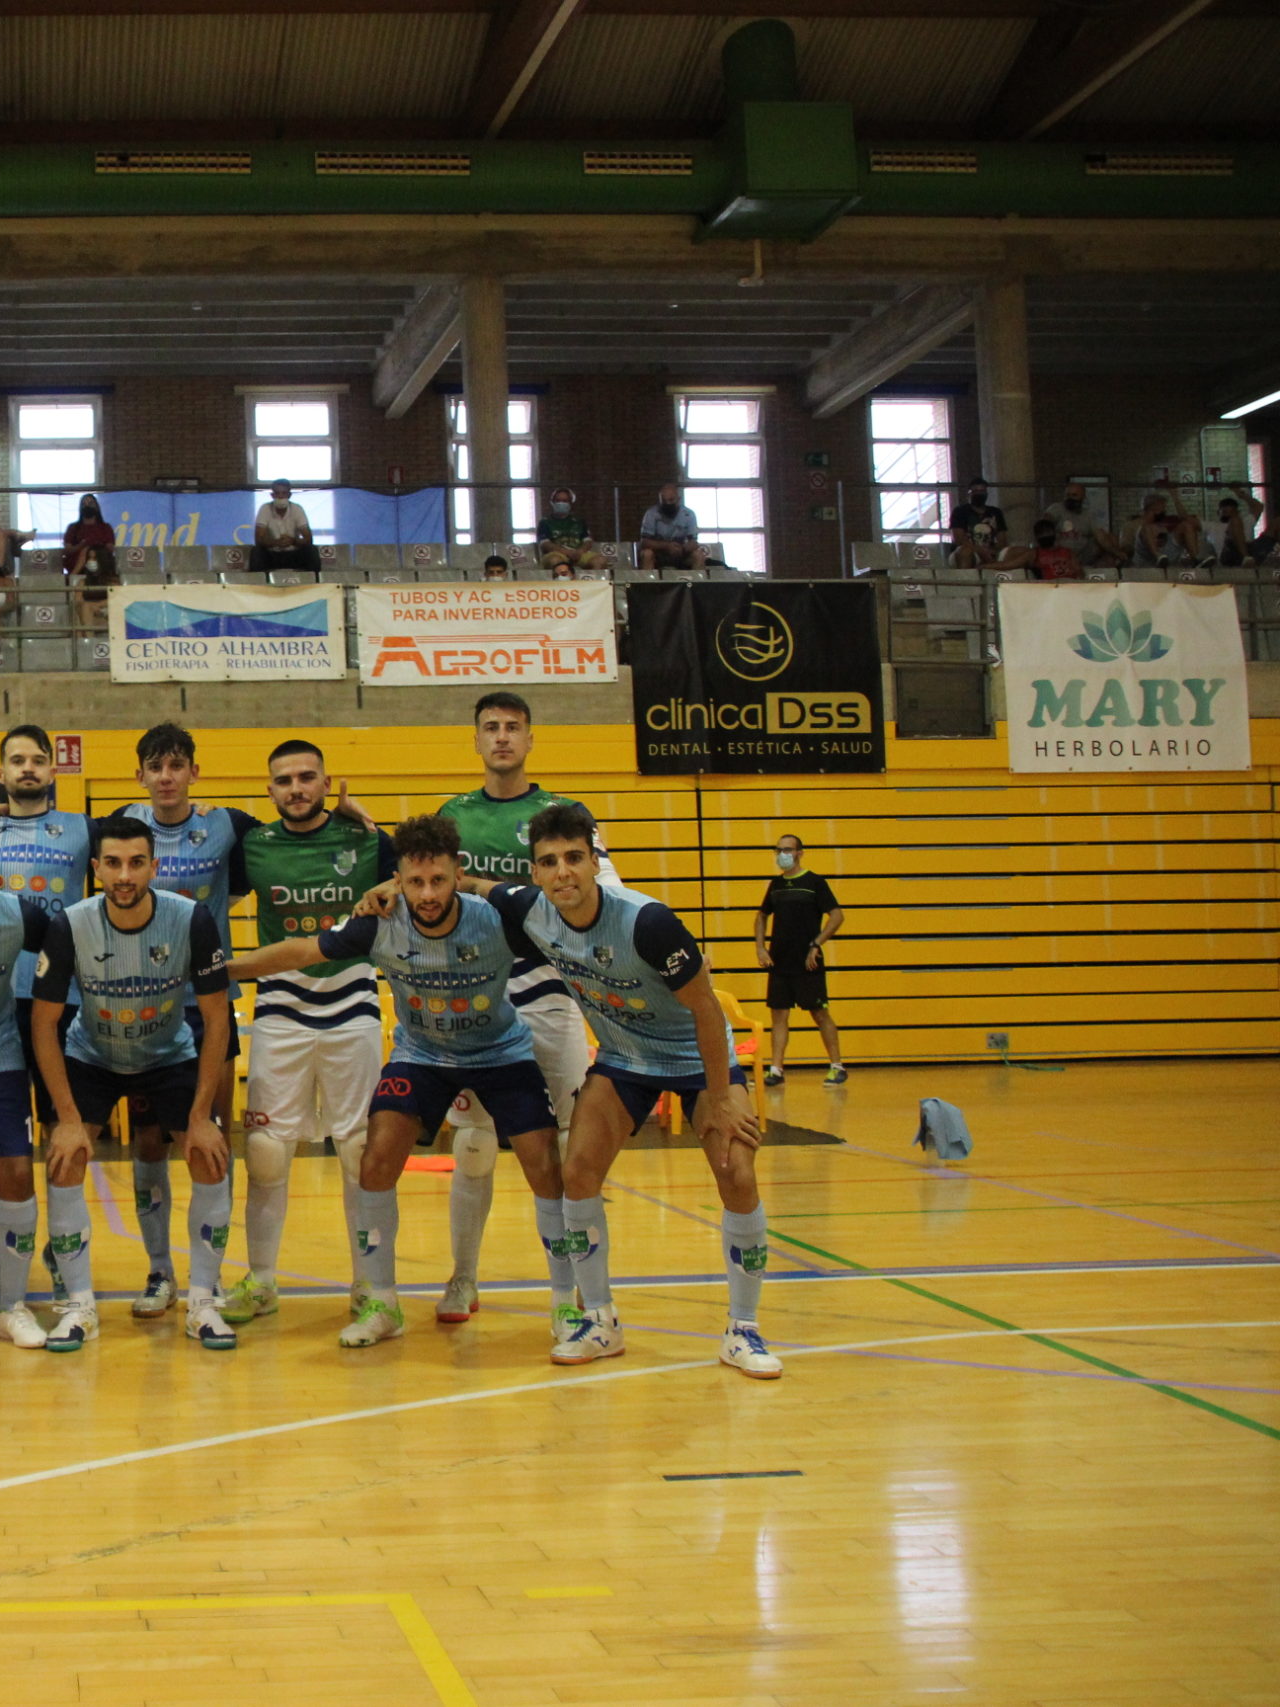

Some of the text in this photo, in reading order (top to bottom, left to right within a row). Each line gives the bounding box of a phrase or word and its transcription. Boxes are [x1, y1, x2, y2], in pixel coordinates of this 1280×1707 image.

[114, 511, 201, 552] imd
[390, 591, 448, 605] TUBOS
[452, 591, 463, 603] Y
[393, 606, 577, 621] PARA INVERNADEROS
[126, 640, 328, 659] CENTRO ALHAMBRA
[371, 637, 607, 677] AGROFILM
[125, 658, 331, 672] FISIOTERAPIA REHABILITACION
[1027, 678, 1226, 728] MARY
[646, 697, 763, 731] clínica
[648, 740, 872, 756] DENTAL ESTÉTICA SALUD
[1035, 739, 1212, 757] HERBOLARIO
[457, 850, 532, 875] Durán
[270, 882, 353, 904] Durán
[97, 1014, 172, 1039] EL EJIDO
[410, 1012, 491, 1032] EL EJIDO
